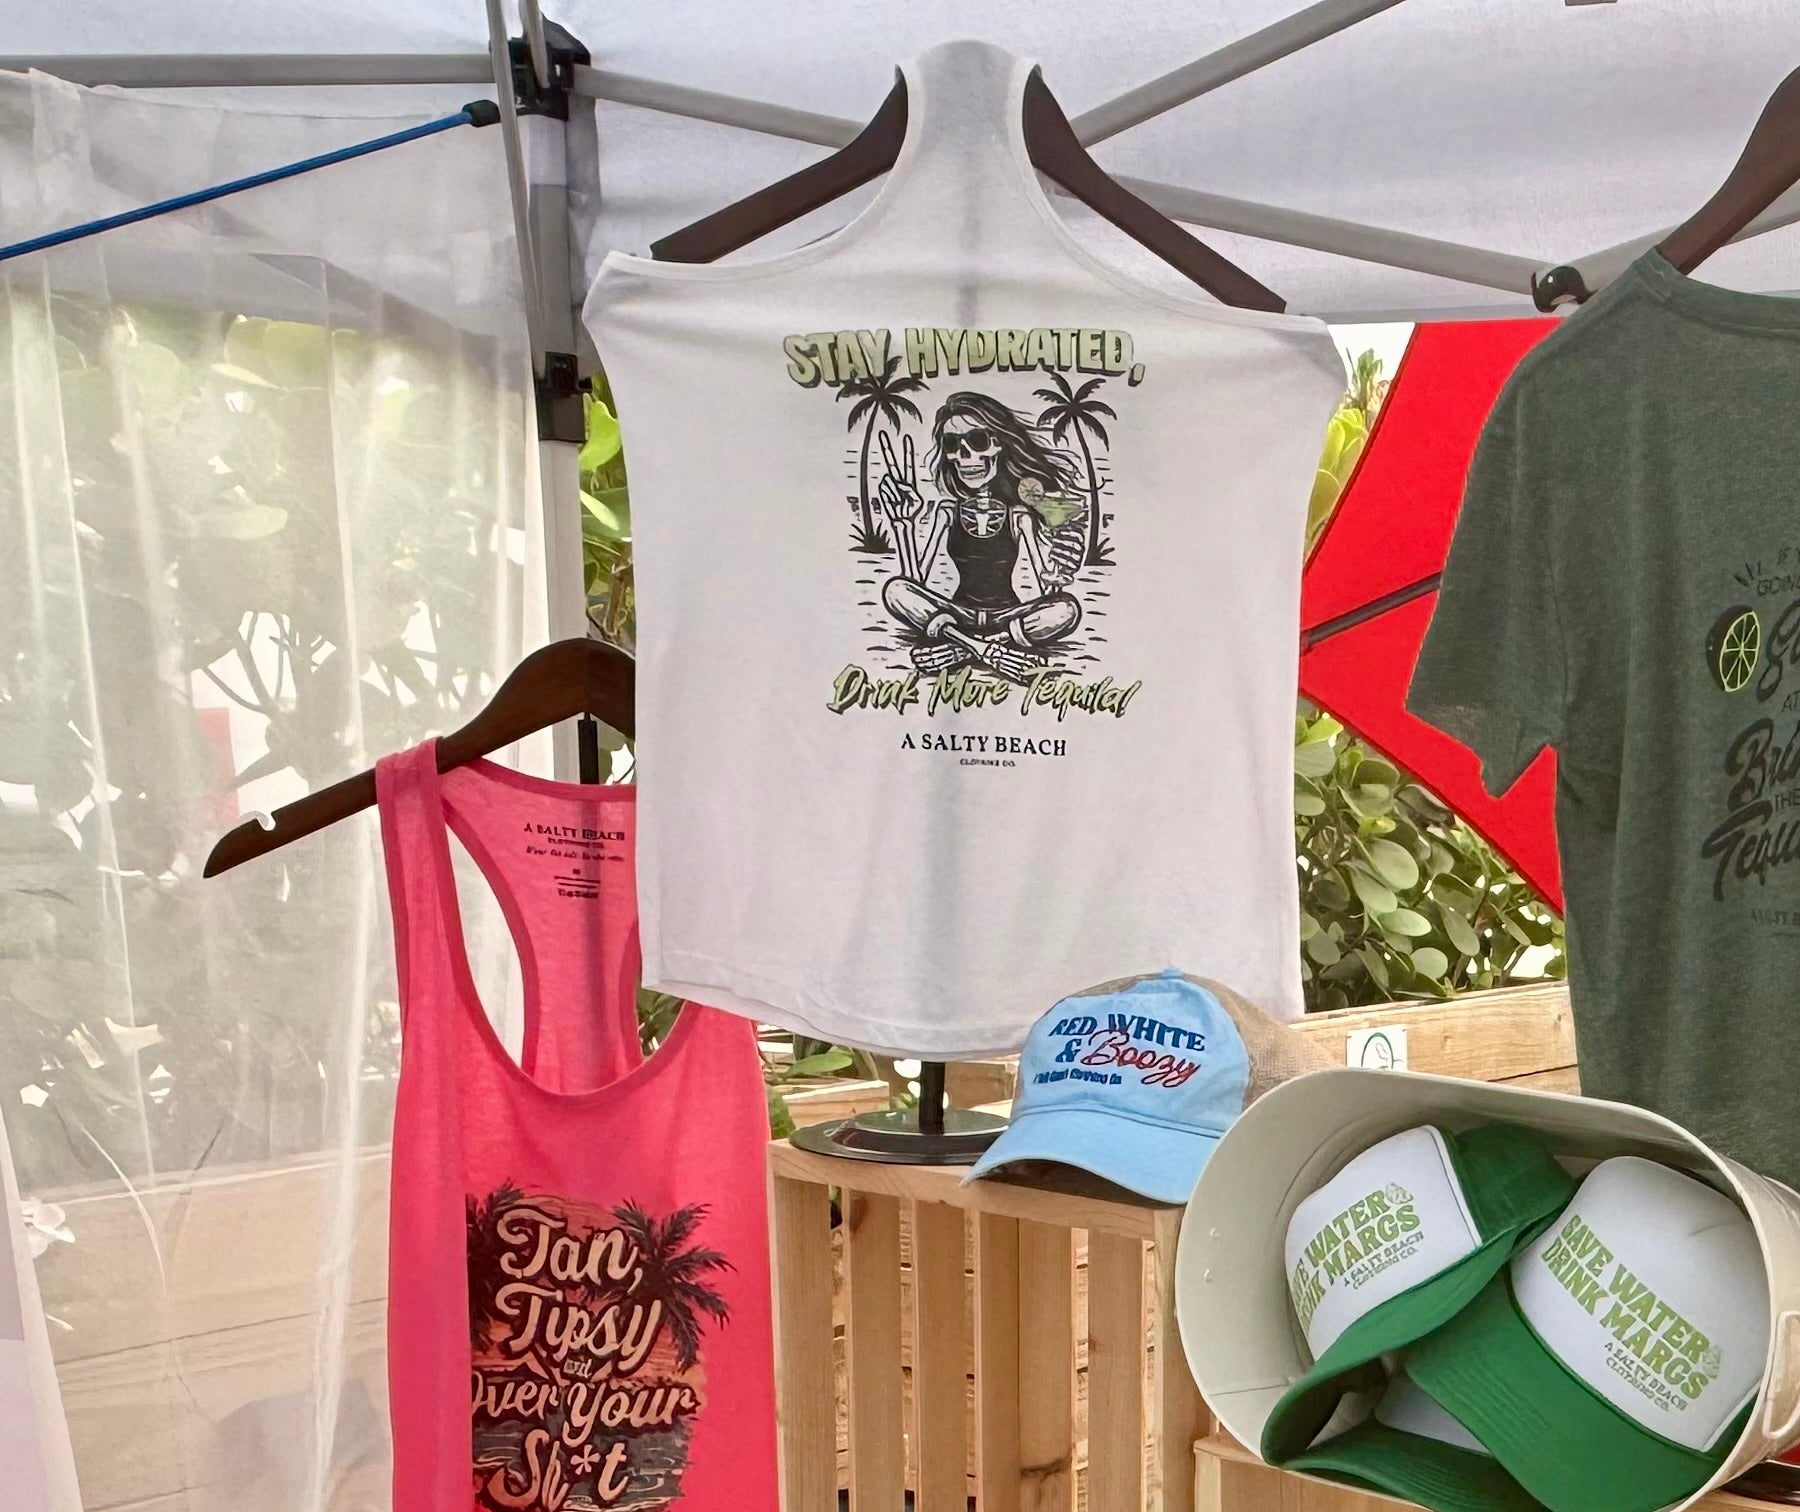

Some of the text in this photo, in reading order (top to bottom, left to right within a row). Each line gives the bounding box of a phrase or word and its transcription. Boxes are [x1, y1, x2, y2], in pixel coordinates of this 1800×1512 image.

[783, 328, 1146, 389] STAY HYDRATED,
[826, 664, 1143, 722] Drink More Tequila!
[900, 733, 1067, 757] A SALTY BEACH
[1048, 1013, 1206, 1052] RED WHITE
[1055, 1028, 1202, 1088] & Boozy
[496, 1207, 644, 1296] Tan,
[1304, 1189, 1391, 1268] WATER
[1323, 1204, 1421, 1286] MARGS
[1385, 1231, 1425, 1258] BEACH
[1541, 1237, 1710, 1400] DRINK MARGS
[1560, 1213, 1710, 1364] SAVE WATER
[495, 1282, 663, 1371] Tipsy
[562, 1356, 593, 1379] and
[1648, 1378, 1689, 1412] BEACH
[562, 1383, 697, 1447] Your
